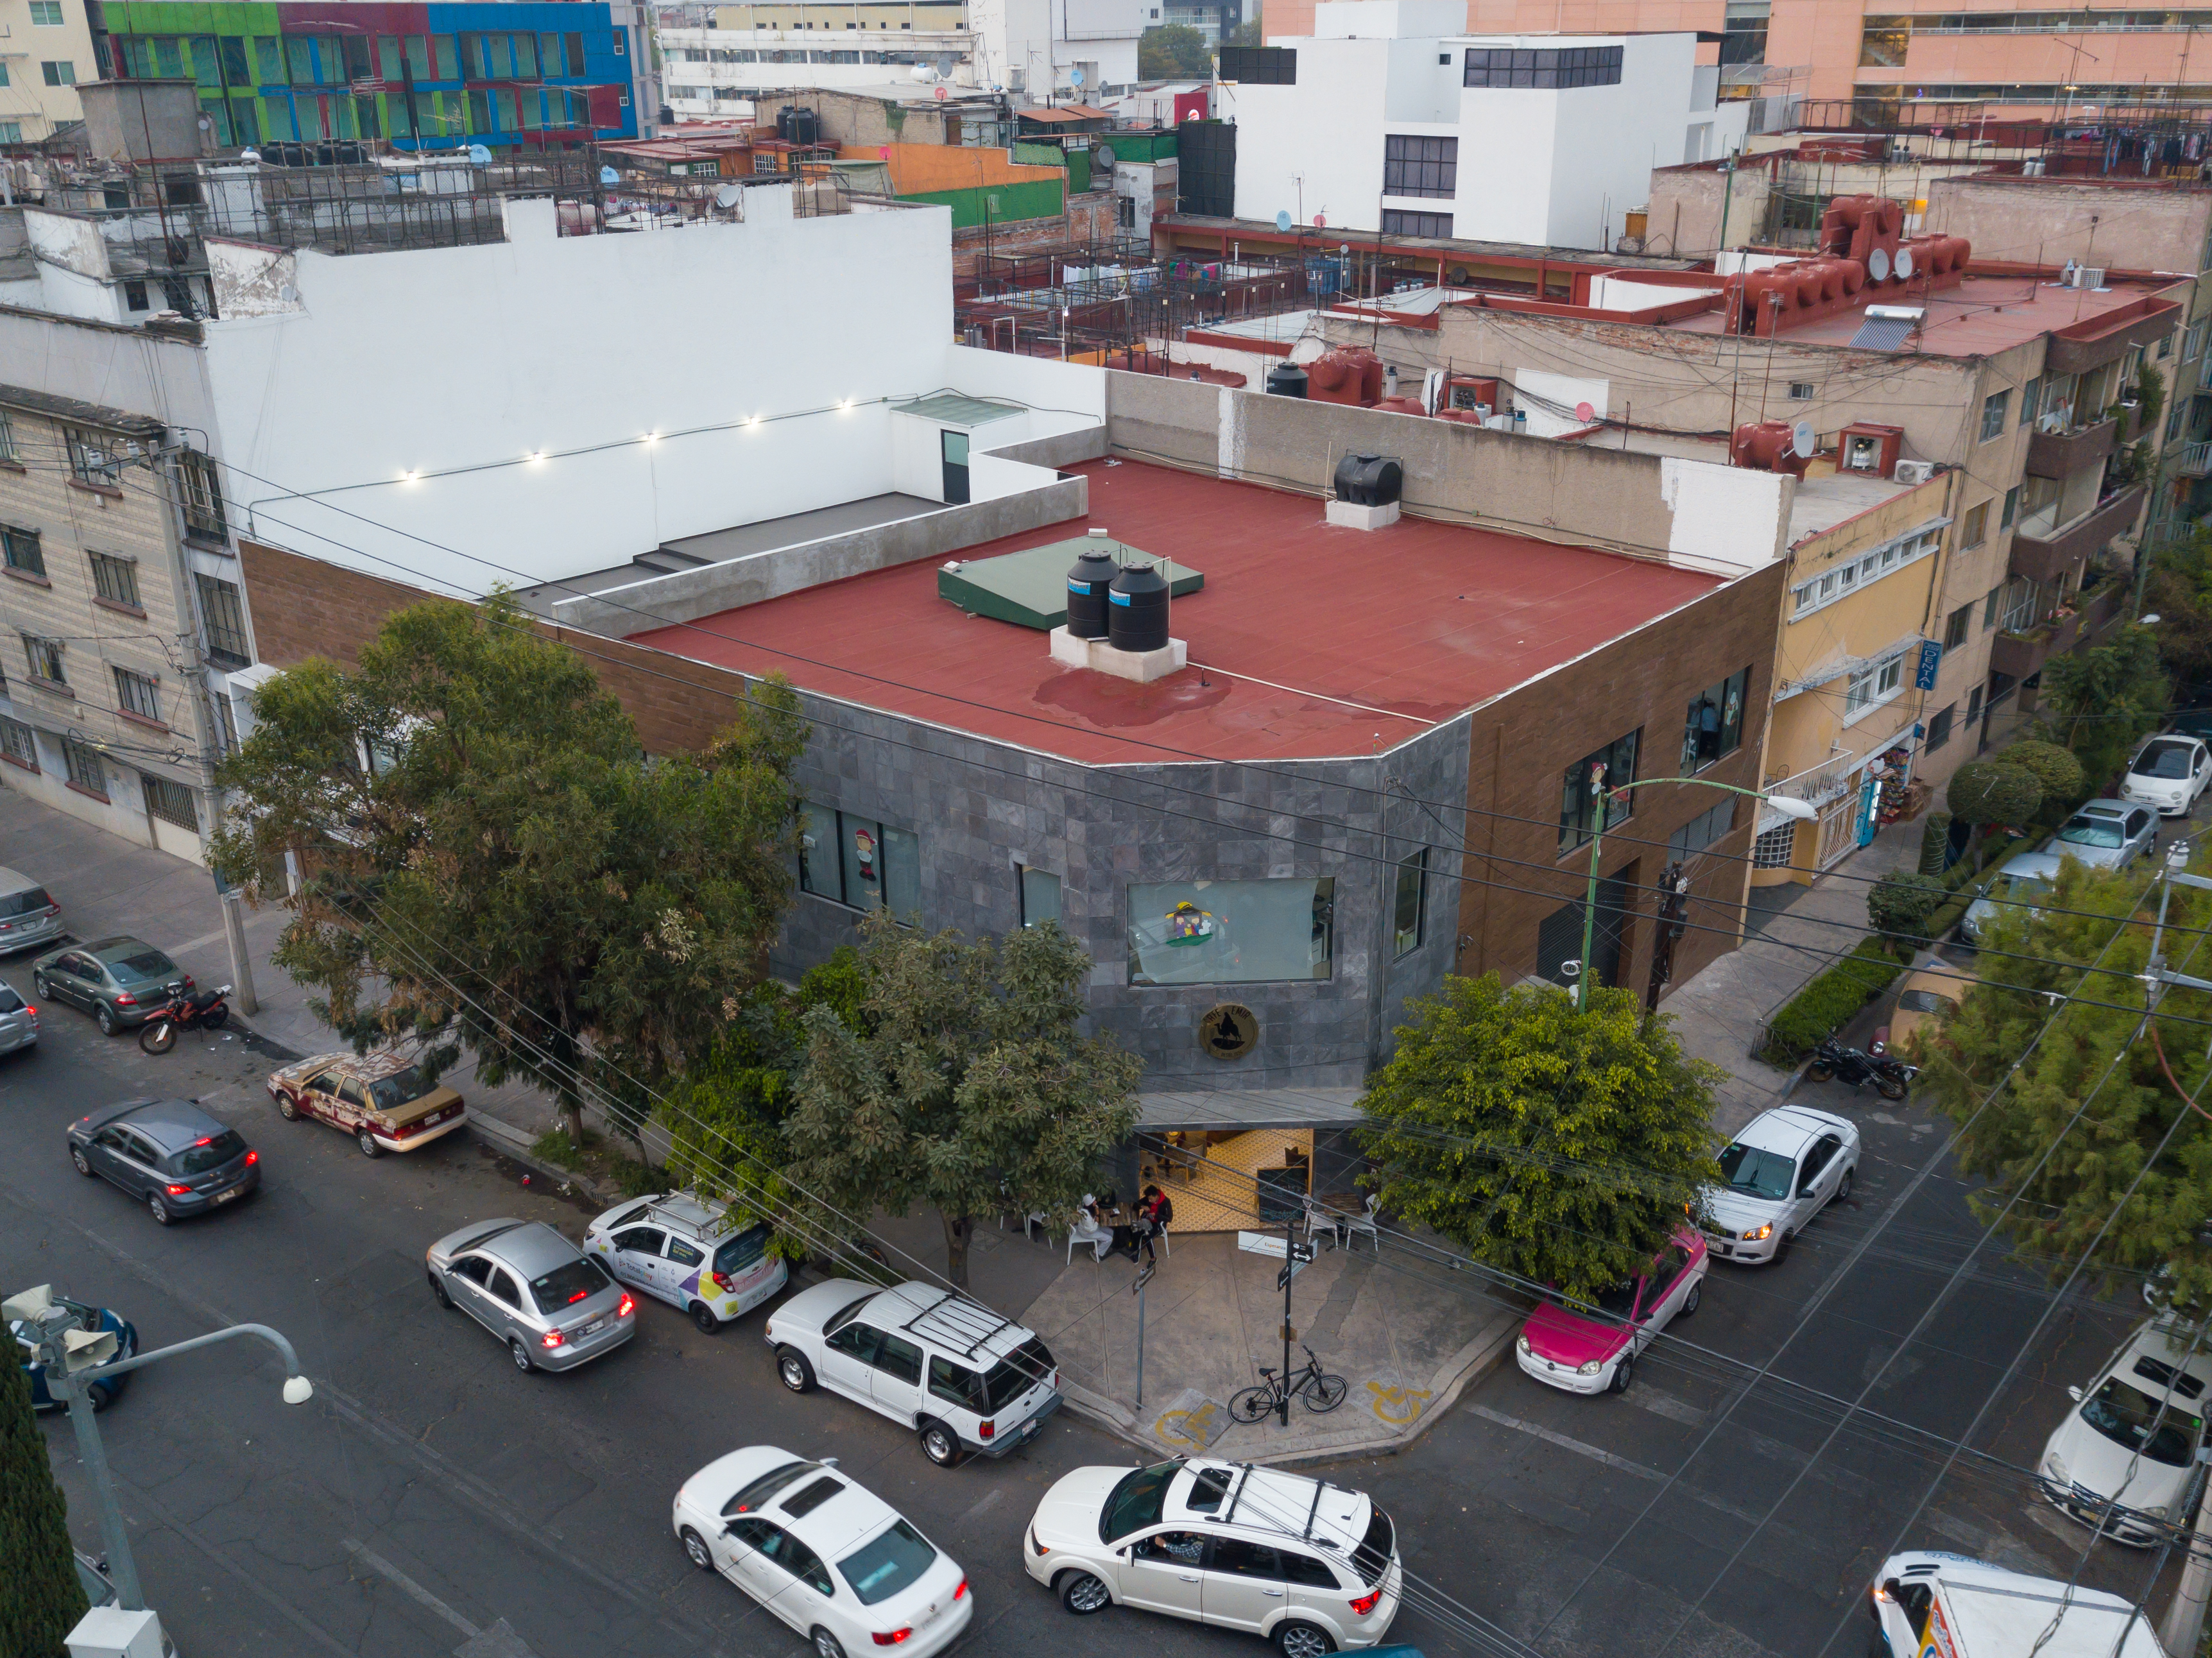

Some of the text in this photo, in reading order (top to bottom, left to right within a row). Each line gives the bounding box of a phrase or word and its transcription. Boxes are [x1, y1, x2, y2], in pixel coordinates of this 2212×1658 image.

[1919, 650, 1937, 689] DENTAL
[1231, 1006, 1251, 1020] EMIR
[1265, 1242, 1286, 1251] Esperanza
